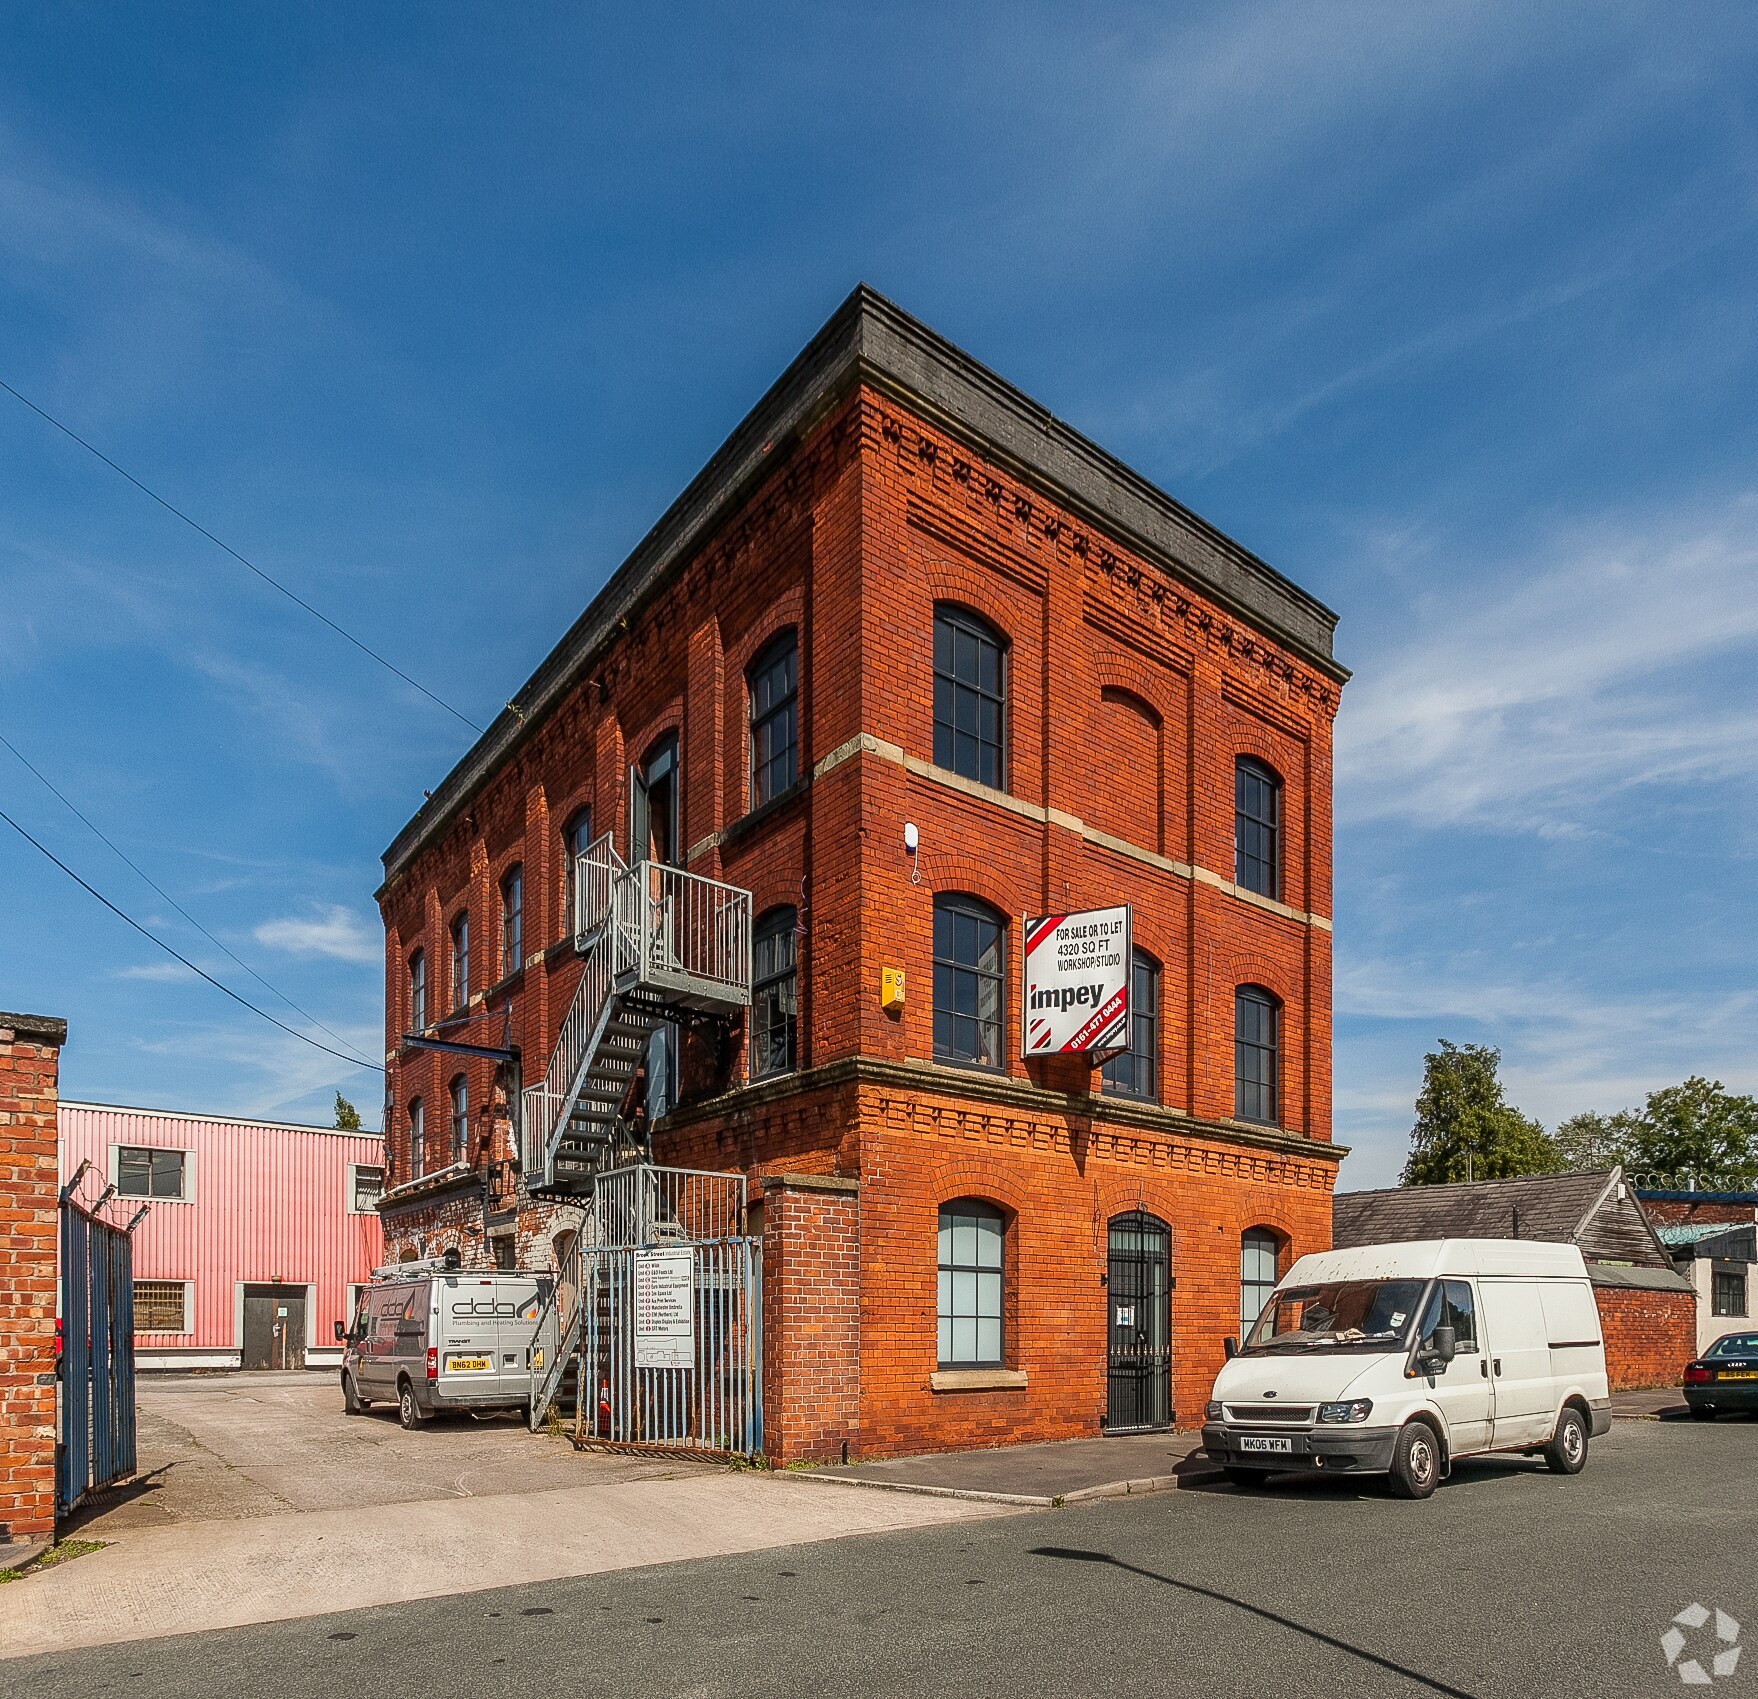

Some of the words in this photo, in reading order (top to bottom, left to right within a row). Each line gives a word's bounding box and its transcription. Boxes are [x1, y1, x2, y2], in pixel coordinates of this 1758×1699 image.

[1056, 928, 1070, 941] FOR
[1071, 926, 1087, 940] SALE
[1088, 924, 1098, 938] OR
[1100, 922, 1109, 936] TO
[1110, 921, 1123, 935] LET
[1057, 943, 1079, 957] 4320
[1081, 941, 1096, 955] SQ
[1099, 939, 1110, 953] FT
[1057, 953, 1121, 972] WORKSHOP/STUDIO
[1030, 984, 1104, 1012] impey
[1070, 1014, 1104, 1049] 0161-477
[1102, 996, 1122, 1018] 0444
[452, 1361, 471, 1369] BN62
[1243, 1438, 1267, 1450] MK06
